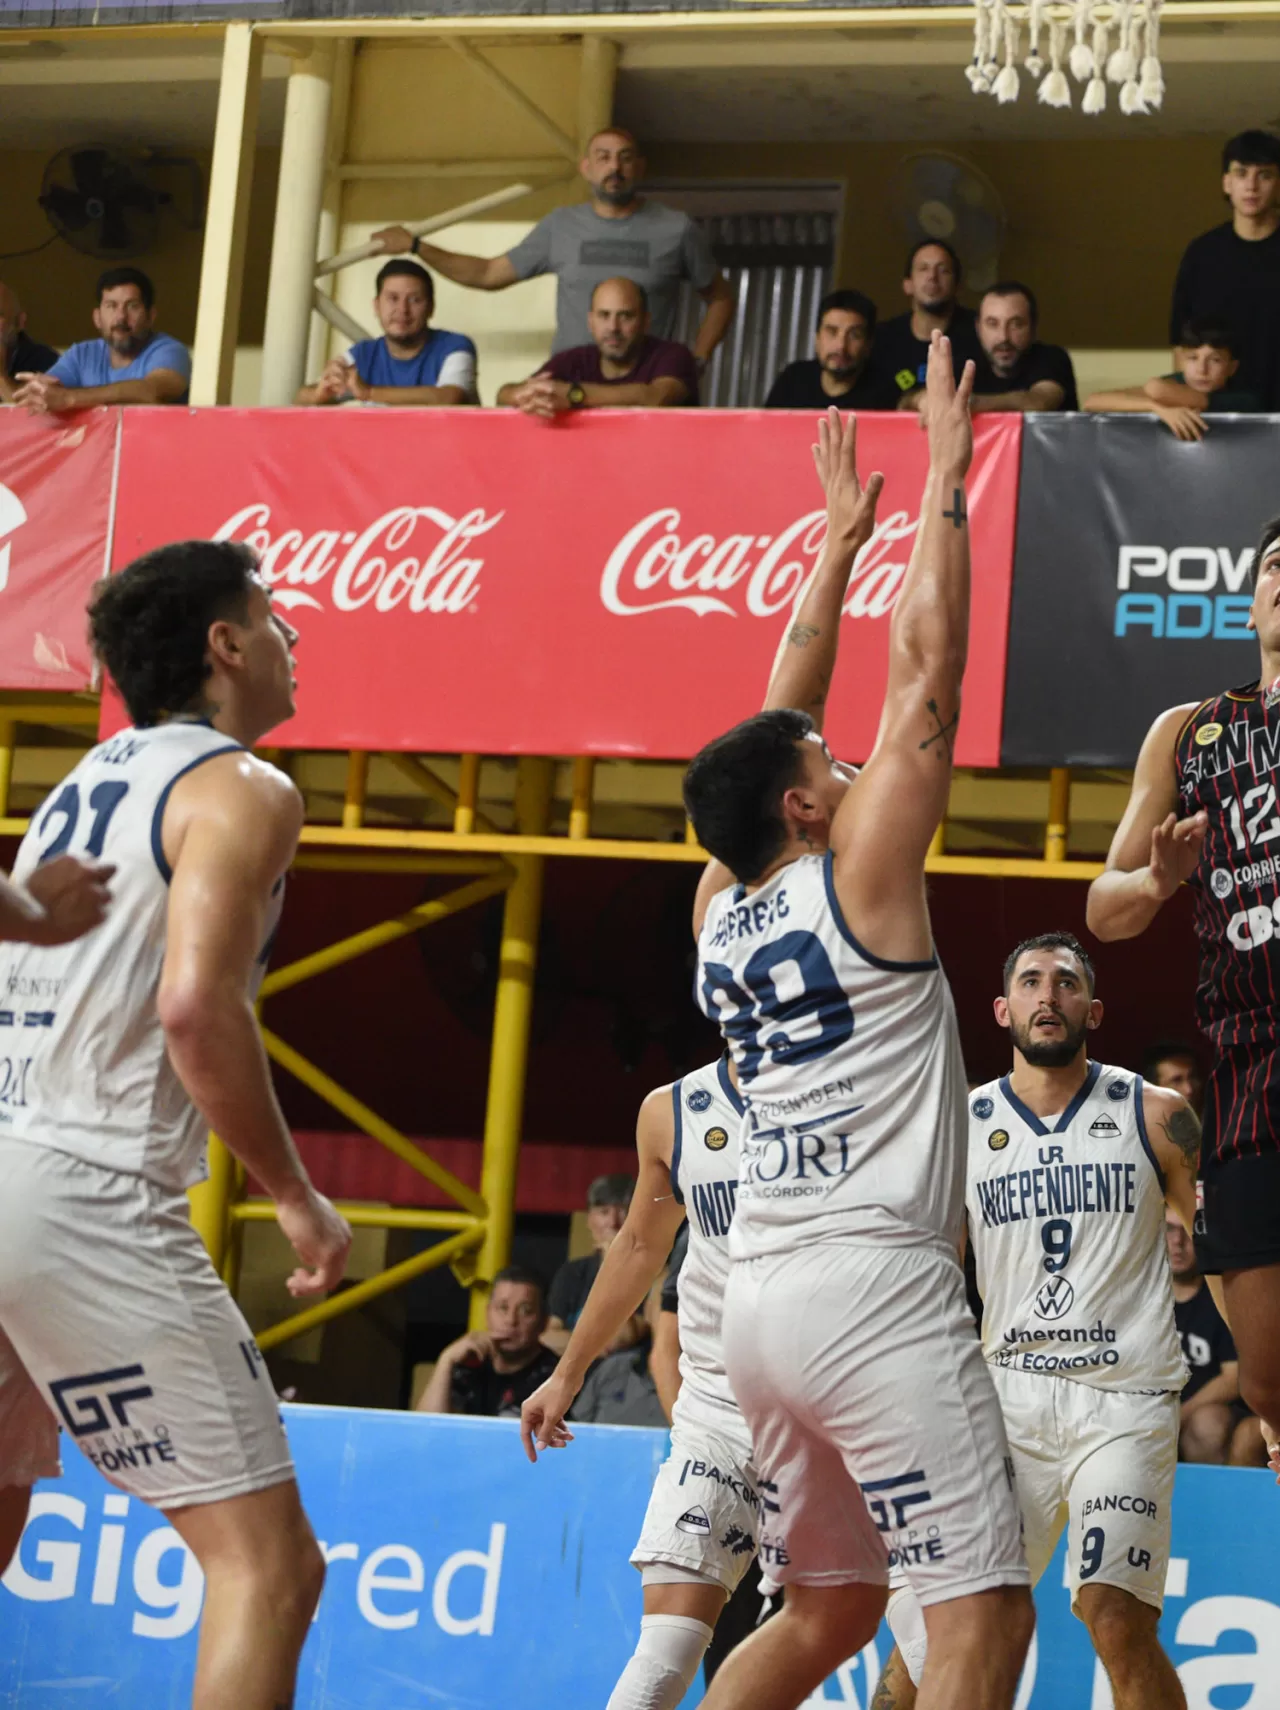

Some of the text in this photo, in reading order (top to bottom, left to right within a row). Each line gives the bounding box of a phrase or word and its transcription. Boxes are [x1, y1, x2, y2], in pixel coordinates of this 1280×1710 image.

[600, 507, 919, 619] Coca-Cla
[1116, 545, 1257, 592] POW
[976, 1163, 1136, 1229] INDEPENDIENTE
[1041, 1219, 1072, 1274] 9
[1021, 1349, 1119, 1371] ECONOVO
[1085, 1495, 1158, 1519] BANCOR
[1, 1491, 507, 1640] Gigred
[888, 1538, 946, 1568] ONTE
[1080, 1526, 1106, 1580] 9
[1127, 1546, 1152, 1571] UR
